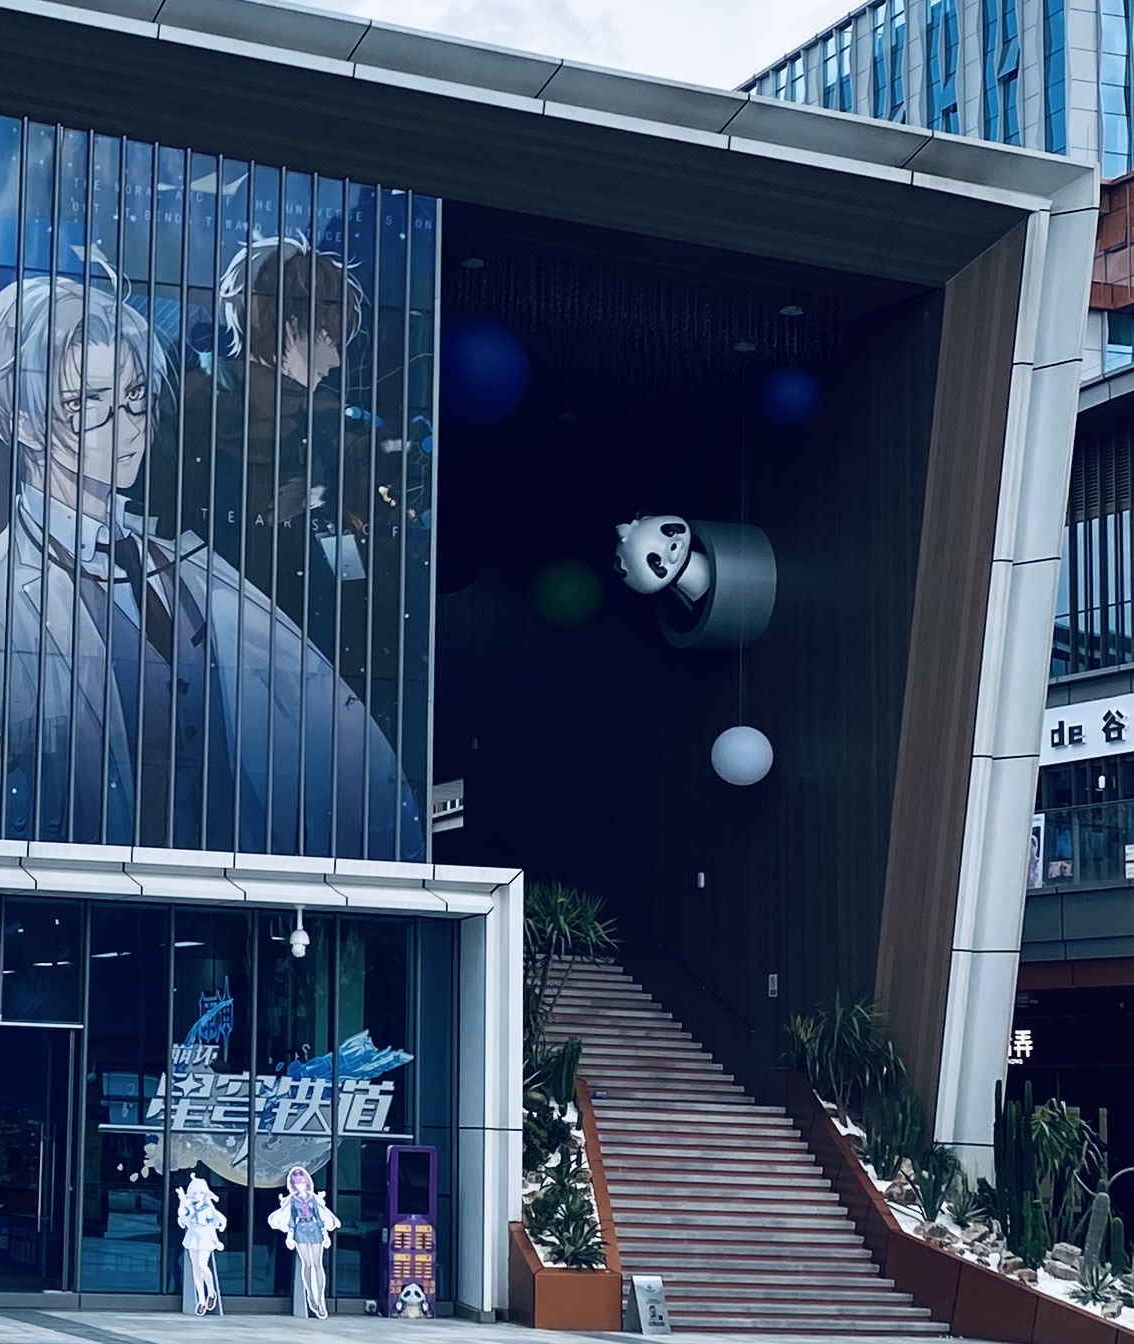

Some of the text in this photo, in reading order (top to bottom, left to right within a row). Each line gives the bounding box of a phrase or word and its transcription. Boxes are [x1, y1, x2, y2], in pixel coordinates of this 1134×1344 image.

[175, 190, 204, 203] AC
[1008, 1030, 1034, 1058] 弄
[146, 1071, 395, 1161] 星穹铁道
